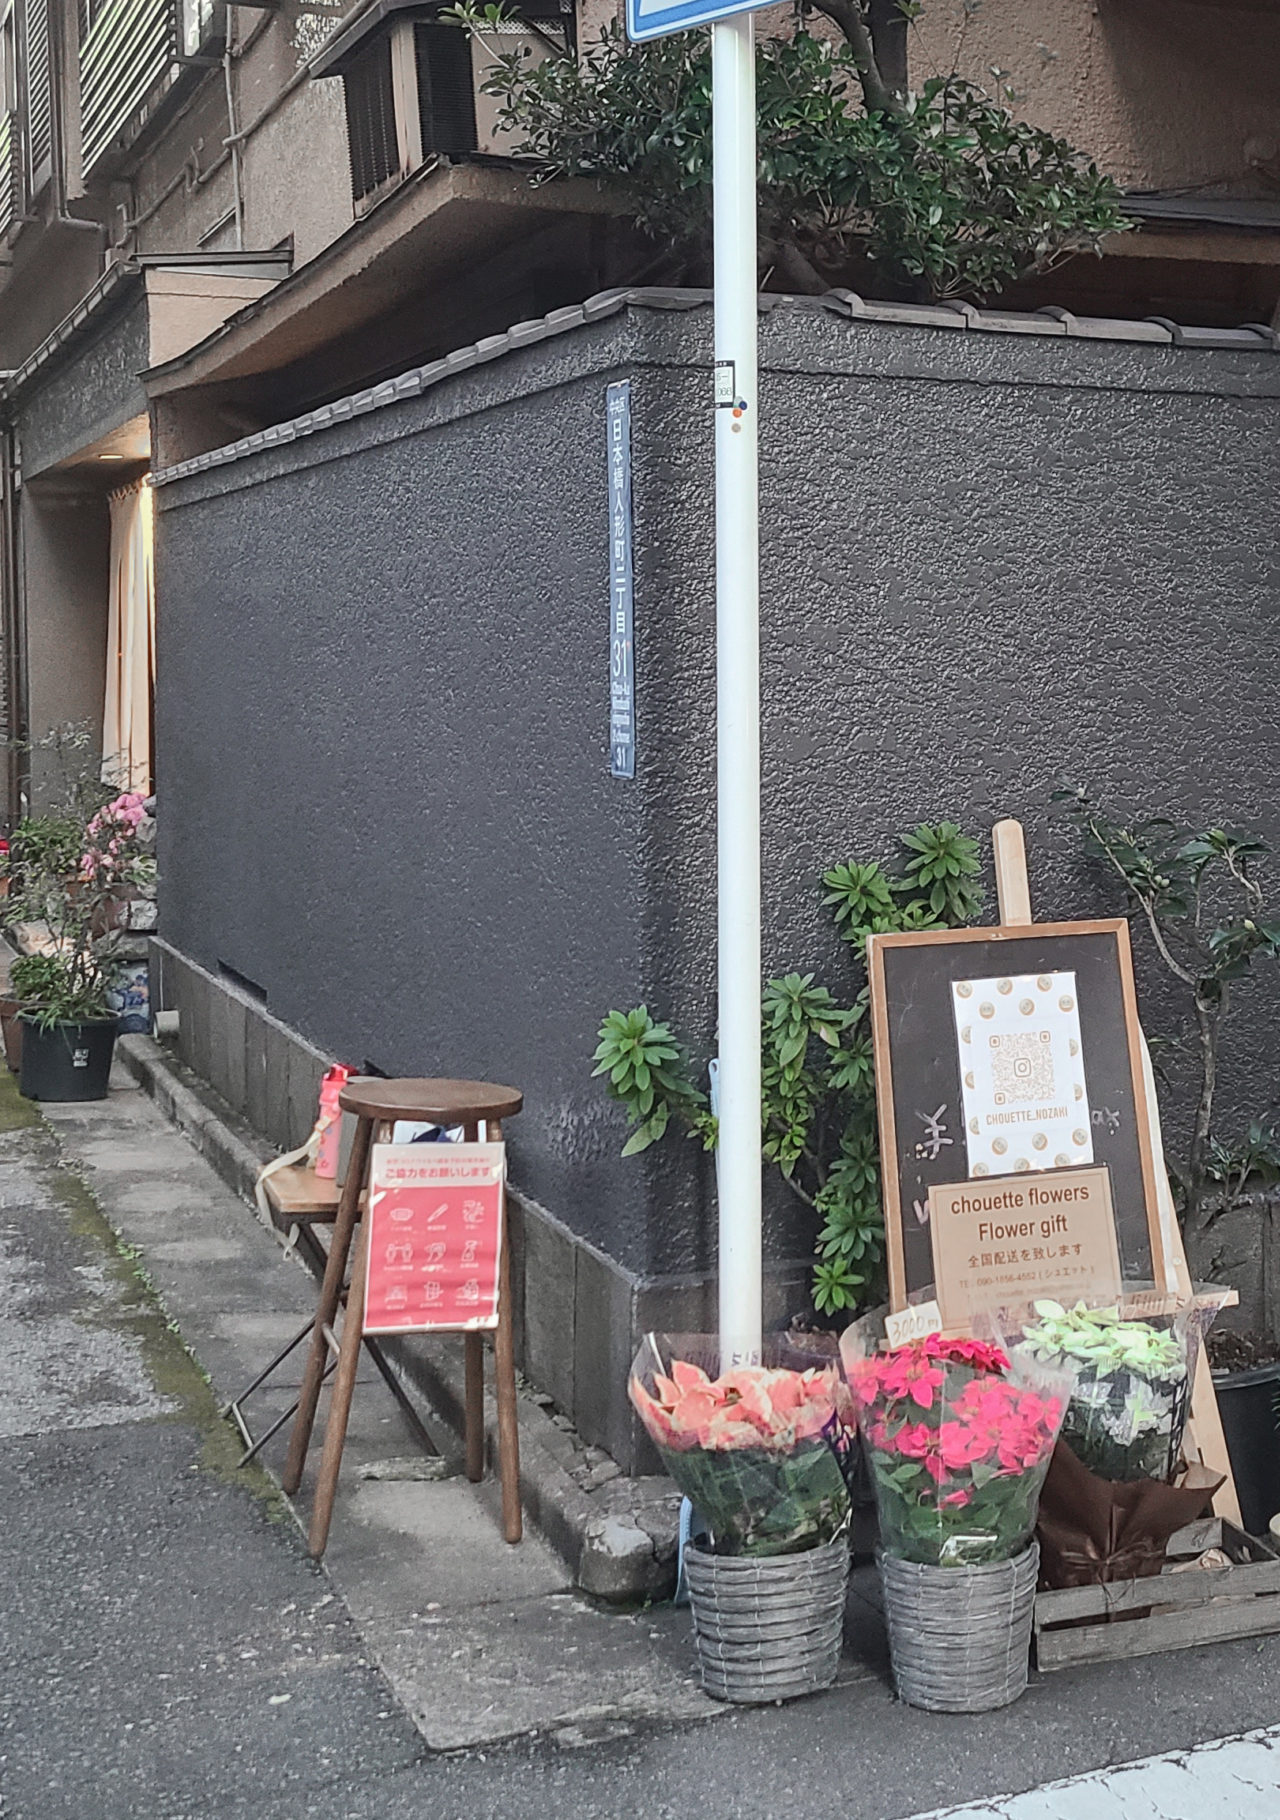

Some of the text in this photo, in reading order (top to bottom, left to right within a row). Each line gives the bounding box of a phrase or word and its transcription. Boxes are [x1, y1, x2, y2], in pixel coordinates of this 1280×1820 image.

[612, 639, 628, 677] 31
[616, 747, 627, 768] 31
[985, 1106, 1068, 1126] CHOUETTE_NOZAKI
[951, 1191, 1024, 1215] chouette
[1028, 1186, 1090, 1206] flowers
[978, 1214, 1068, 1242] Flower gift
[968, 1243, 1083, 1269] 全国配送を致します
